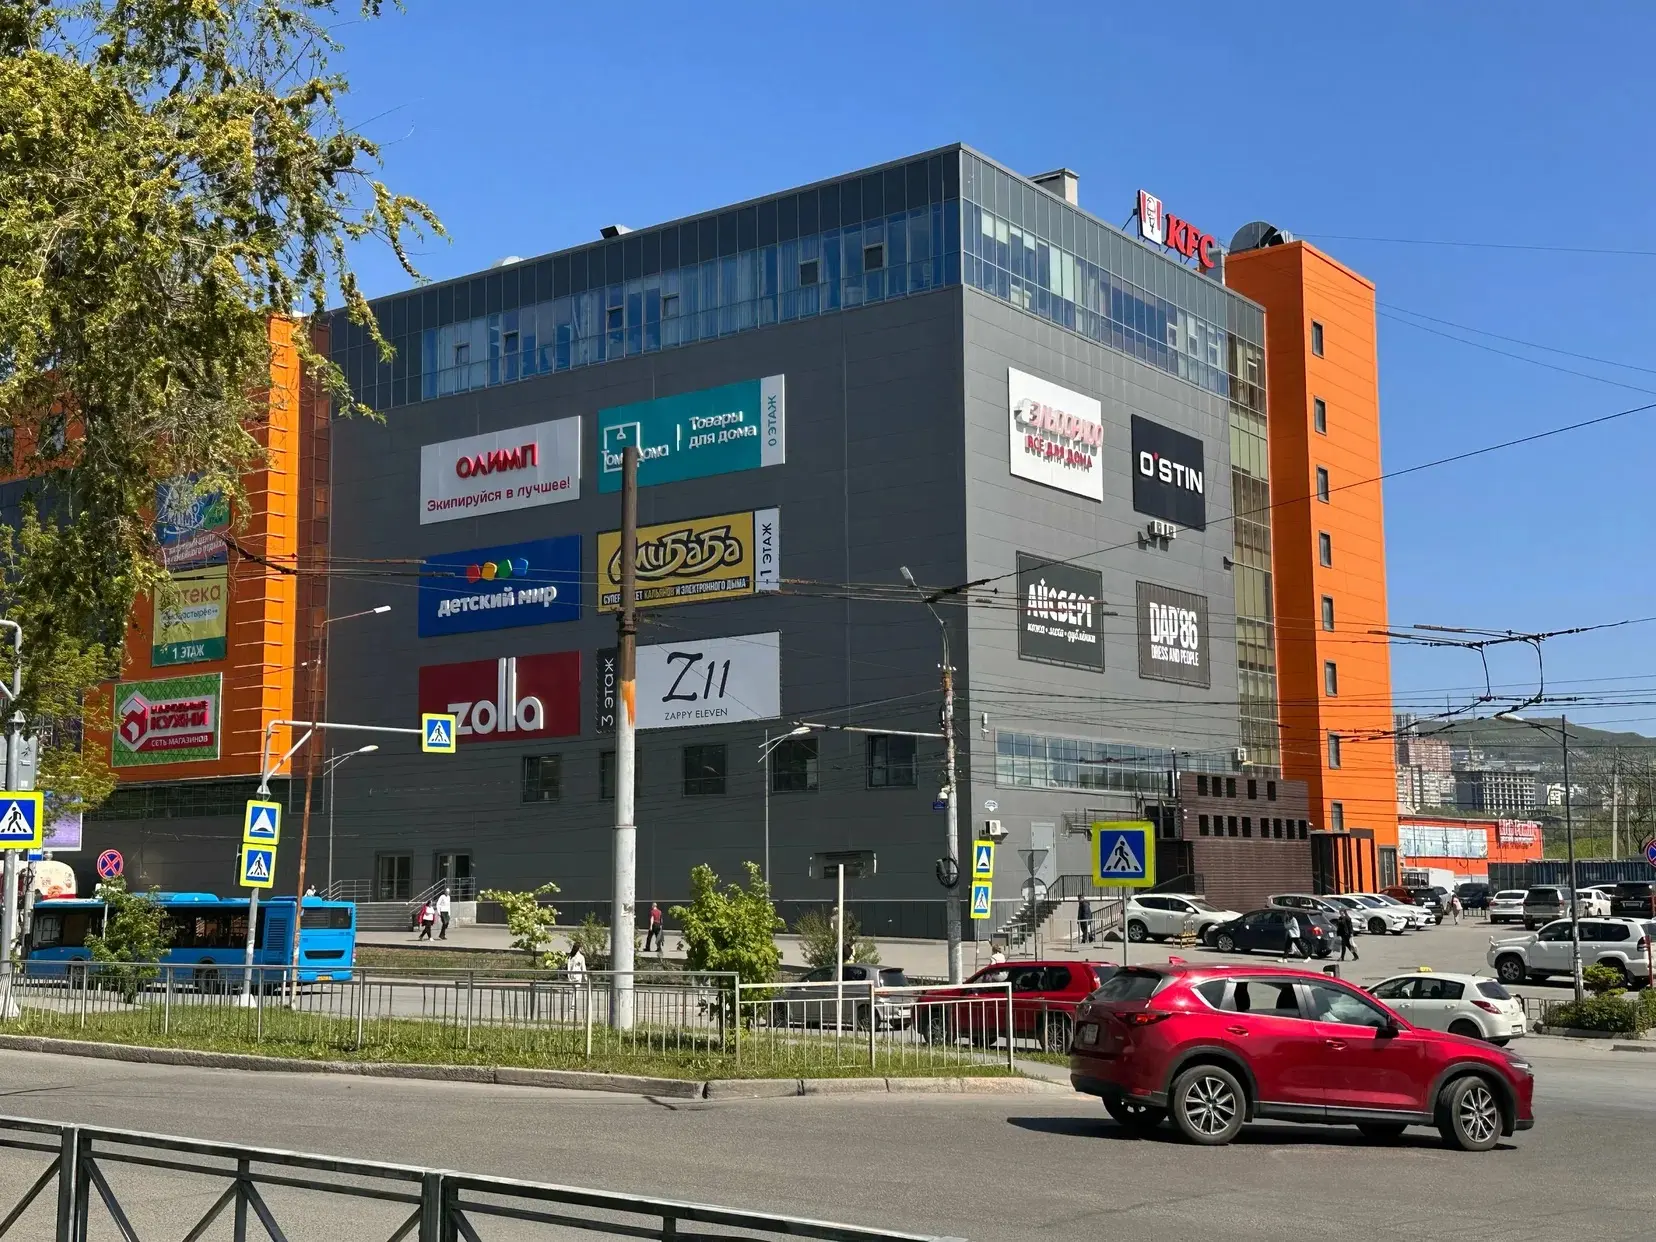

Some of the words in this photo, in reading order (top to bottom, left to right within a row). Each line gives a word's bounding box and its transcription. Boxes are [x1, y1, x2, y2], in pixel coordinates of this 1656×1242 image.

[1165, 213, 1215, 268] KFC
[689, 410, 743, 430] Товары
[768, 395, 777, 435] ЭТАЖ
[689, 432, 715, 449] для
[718, 425, 757, 443] дома
[456, 442, 539, 478] ОЛИМП
[1066, 448, 1093, 468] ДОМА
[1140, 451, 1203, 494] O'STIN
[427, 490, 501, 511] Экипируйся
[506, 488, 513, 498] в
[517, 476, 570, 498] лучшее!
[762, 523, 772, 565] ЭТАЖ
[438, 587, 514, 617] детский
[518, 586, 557, 607] мир
[604, 590, 643, 604] СУПЕРЕТ
[681, 580, 725, 594] ЭЛЕКТРОННОГО
[726, 577, 746, 590] ДЫМА
[172, 648, 178, 660] 1
[180, 643, 205, 658] ЭТАЖ
[1169, 647, 1180, 662] AND
[1180, 649, 1199, 666] PEOPLE
[447, 657, 544, 735] zolla
[604, 658, 614, 709] этаж
[151, 711, 208, 730] КУХНИ
[601, 714, 614, 726] 3
[665, 711, 693, 720] ZAPPY
[696, 708, 728, 718] ELEVEN
[168, 735, 208, 745] МАГАЗИНОВ
